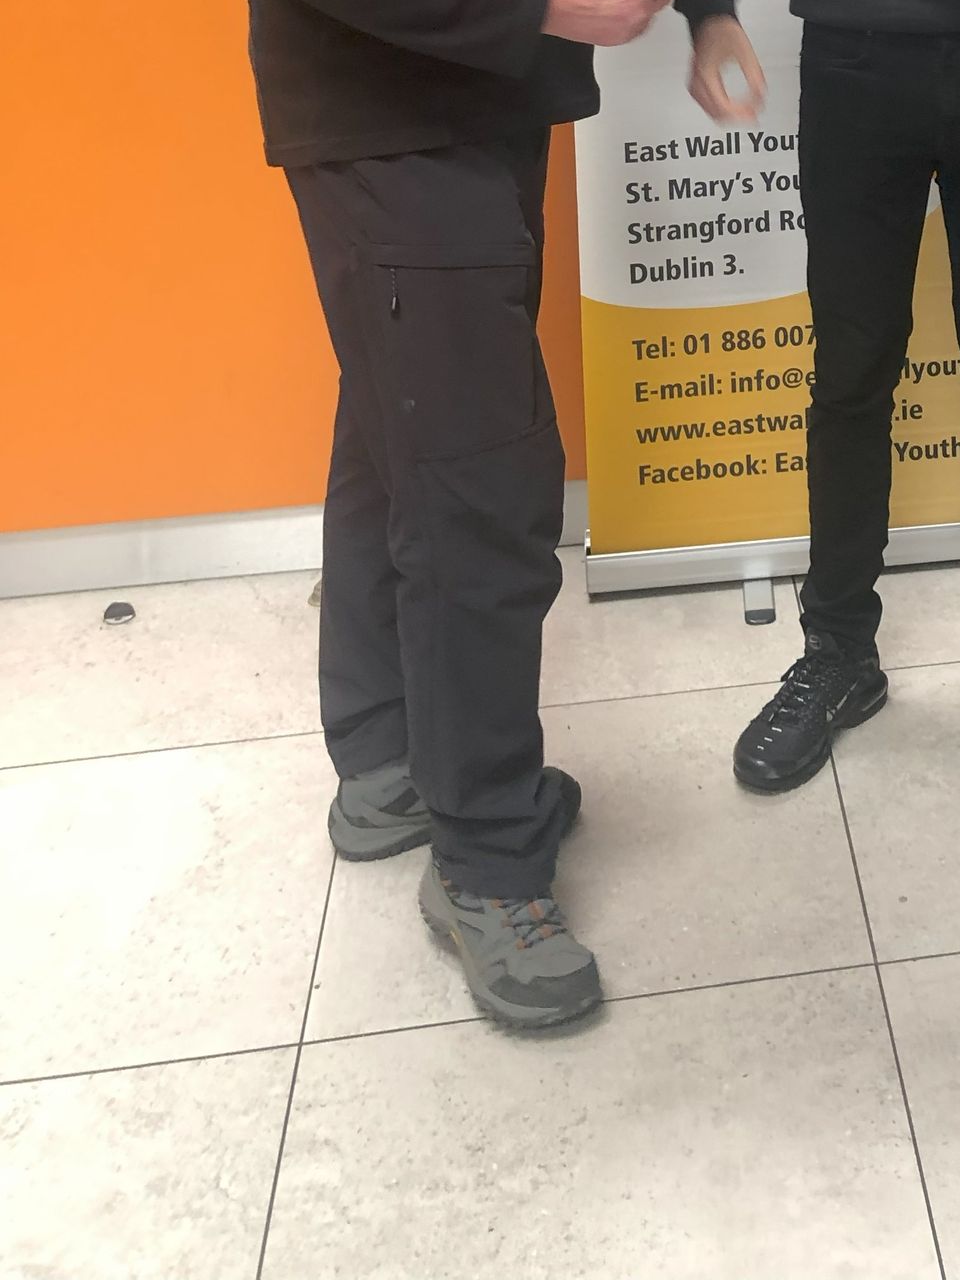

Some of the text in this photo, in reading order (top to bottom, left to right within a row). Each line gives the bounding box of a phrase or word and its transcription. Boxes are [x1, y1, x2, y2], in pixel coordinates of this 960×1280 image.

[624, 139, 679, 164] East
[685, 132, 741, 158] Wall
[625, 182, 660, 204] St.
[668, 171, 754, 202] Mary's
[627, 210, 770, 245] Strangford
[629, 254, 745, 285] Dublin 3.
[632, 336, 676, 361] Tel:
[683, 333, 710, 356] 01
[721, 328, 767, 352] 886
[635, 373, 723, 403] E-mail:
[638, 454, 767, 486] Facebook:
[775, 451, 809, 473] Ea
